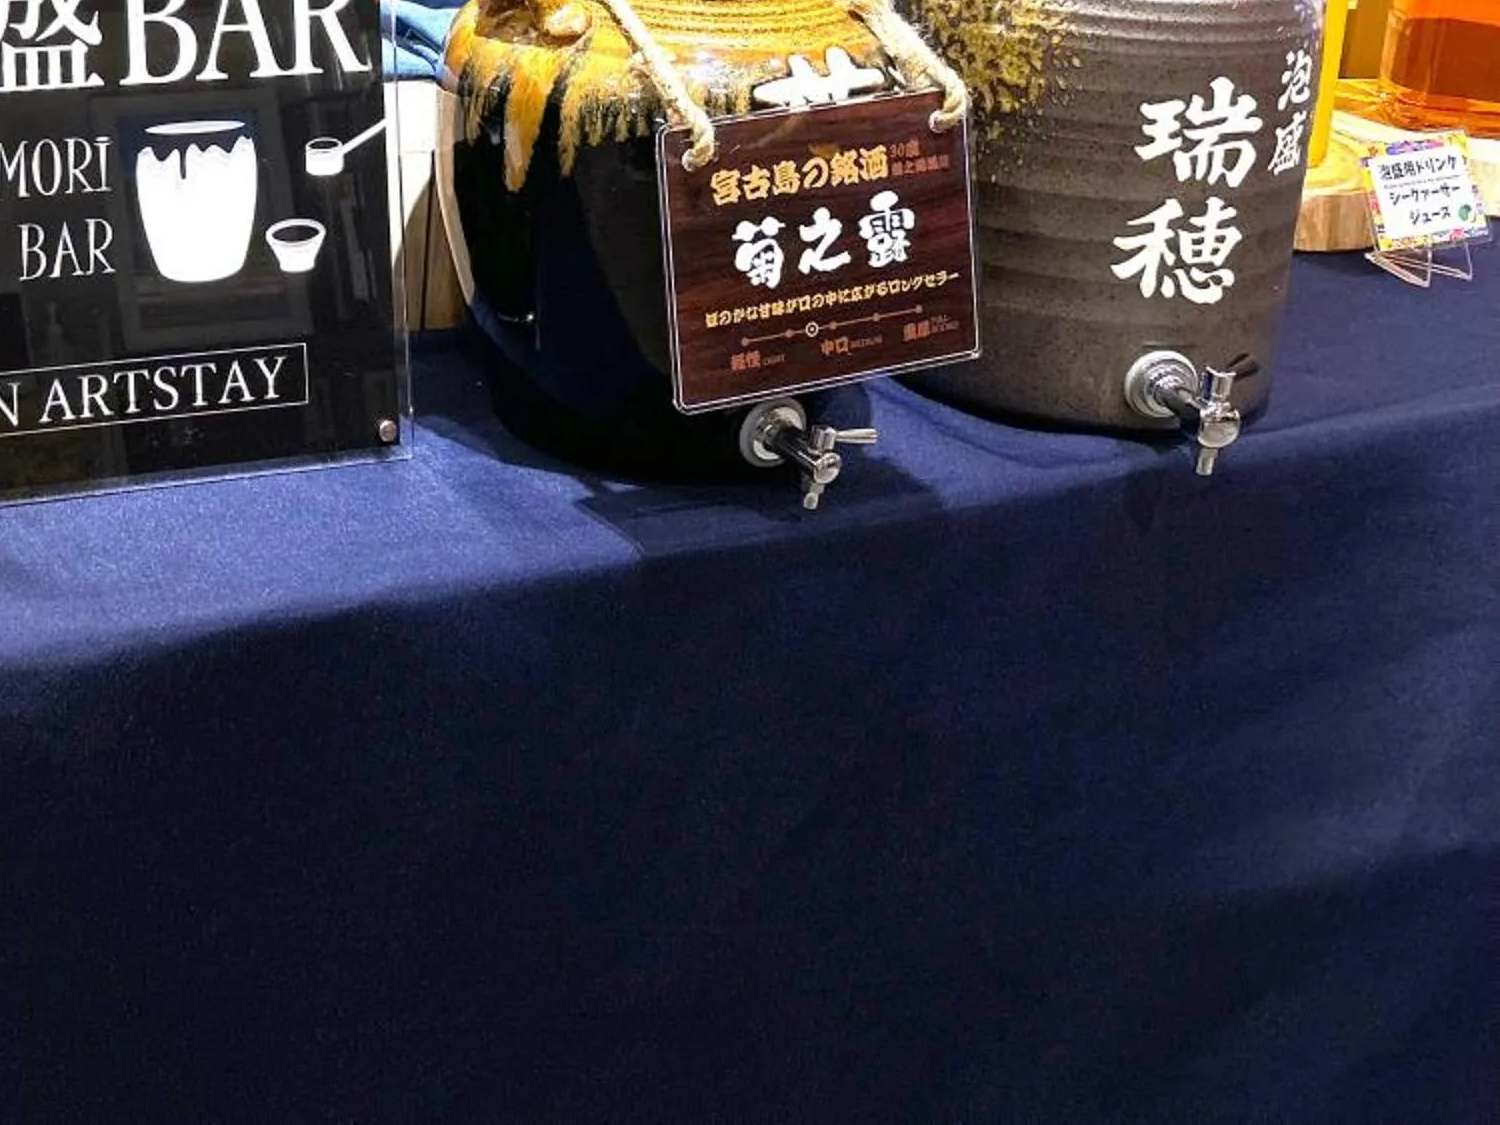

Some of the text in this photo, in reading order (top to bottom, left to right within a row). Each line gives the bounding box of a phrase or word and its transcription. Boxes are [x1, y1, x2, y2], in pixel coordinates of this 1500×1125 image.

[1267, 49, 1313, 175] 泡盛
[710, 144, 889, 206] 宮古島の銘酒
[1109, 76, 1263, 304] 瑞穂
[18, 218, 116, 282] BAR
[732, 190, 915, 289] 菊之露
[40, 355, 287, 422] ARTSTAY
